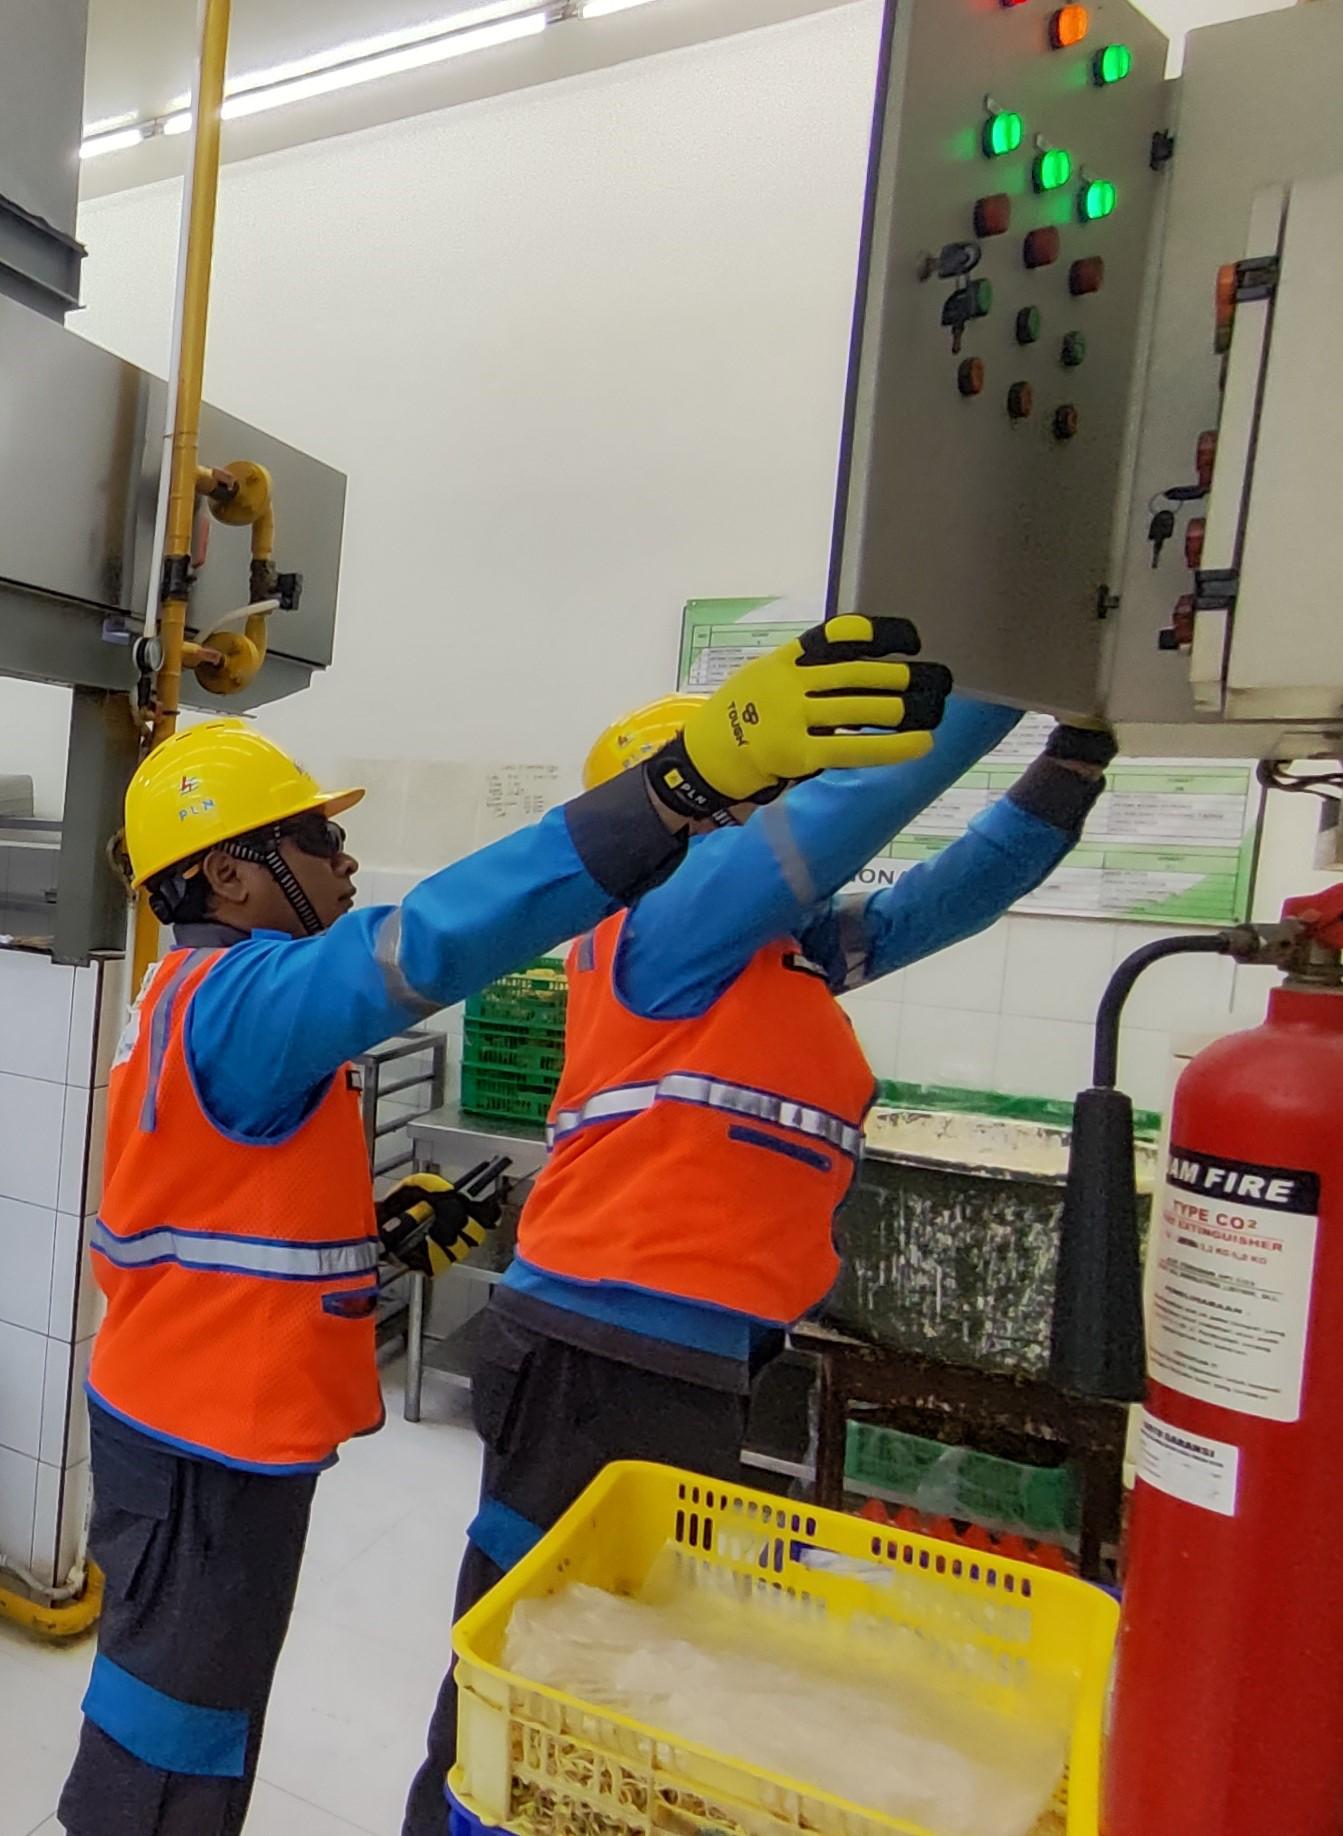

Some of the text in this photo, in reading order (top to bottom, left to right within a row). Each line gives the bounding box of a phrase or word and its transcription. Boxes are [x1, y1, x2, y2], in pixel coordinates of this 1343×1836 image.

[680, 782, 707, 805] PLN
[178, 799, 215, 822] PLN
[1203, 1167, 1295, 1204] FIRE
[1173, 1199, 1209, 1223] TYPE
[1178, 1218, 1283, 1252] EXTINGUISHER
